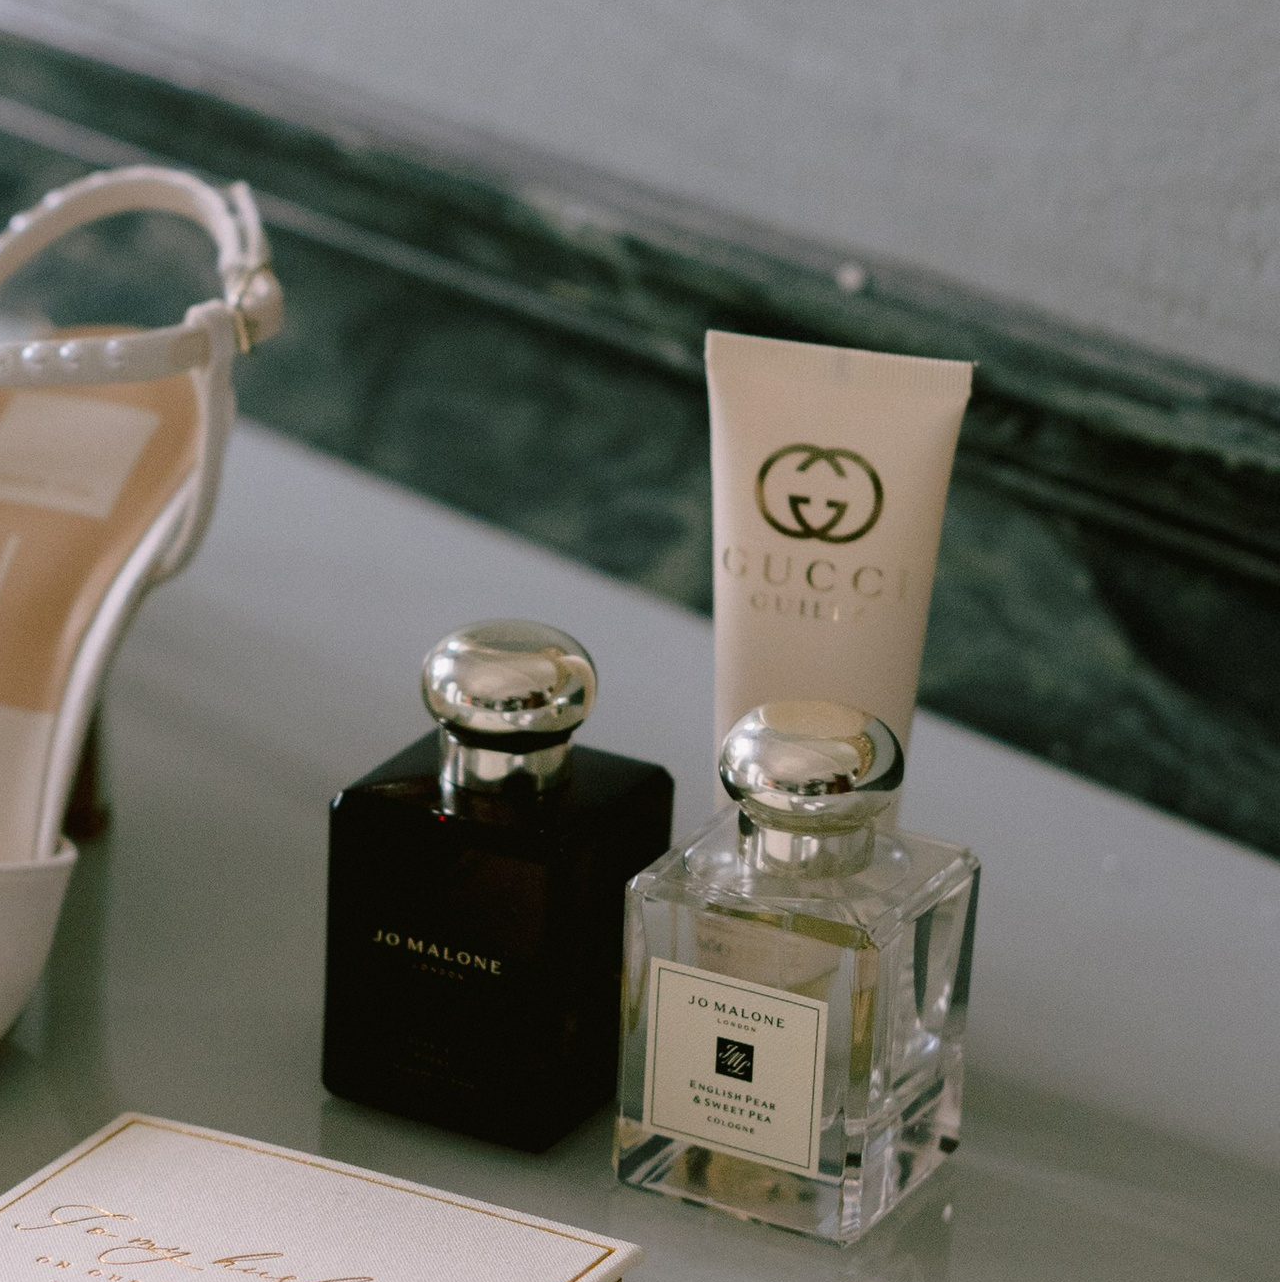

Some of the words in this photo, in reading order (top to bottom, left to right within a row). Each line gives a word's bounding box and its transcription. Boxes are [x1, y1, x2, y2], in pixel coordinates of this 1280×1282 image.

[722, 546, 908, 601] GUCCI
[373, 929, 400, 946] JO
[407, 937, 502, 975] MALONE
[688, 995, 709, 1008] JO
[714, 1001, 786, 1029] MALONE
[717, 1017, 757, 1032] LONDON
[689, 1079, 742, 1101] ENGLISH
[745, 1094, 776, 1111] PEAR
[693, 1095, 701, 1104] &
[704, 1098, 745, 1116] SWEET
[749, 1110, 772, 1124] PEA
[707, 1115, 755, 1134] COLOGNE
[35, 1256, 72, 1269] ON
[97, 1237, 205, 1271] my
